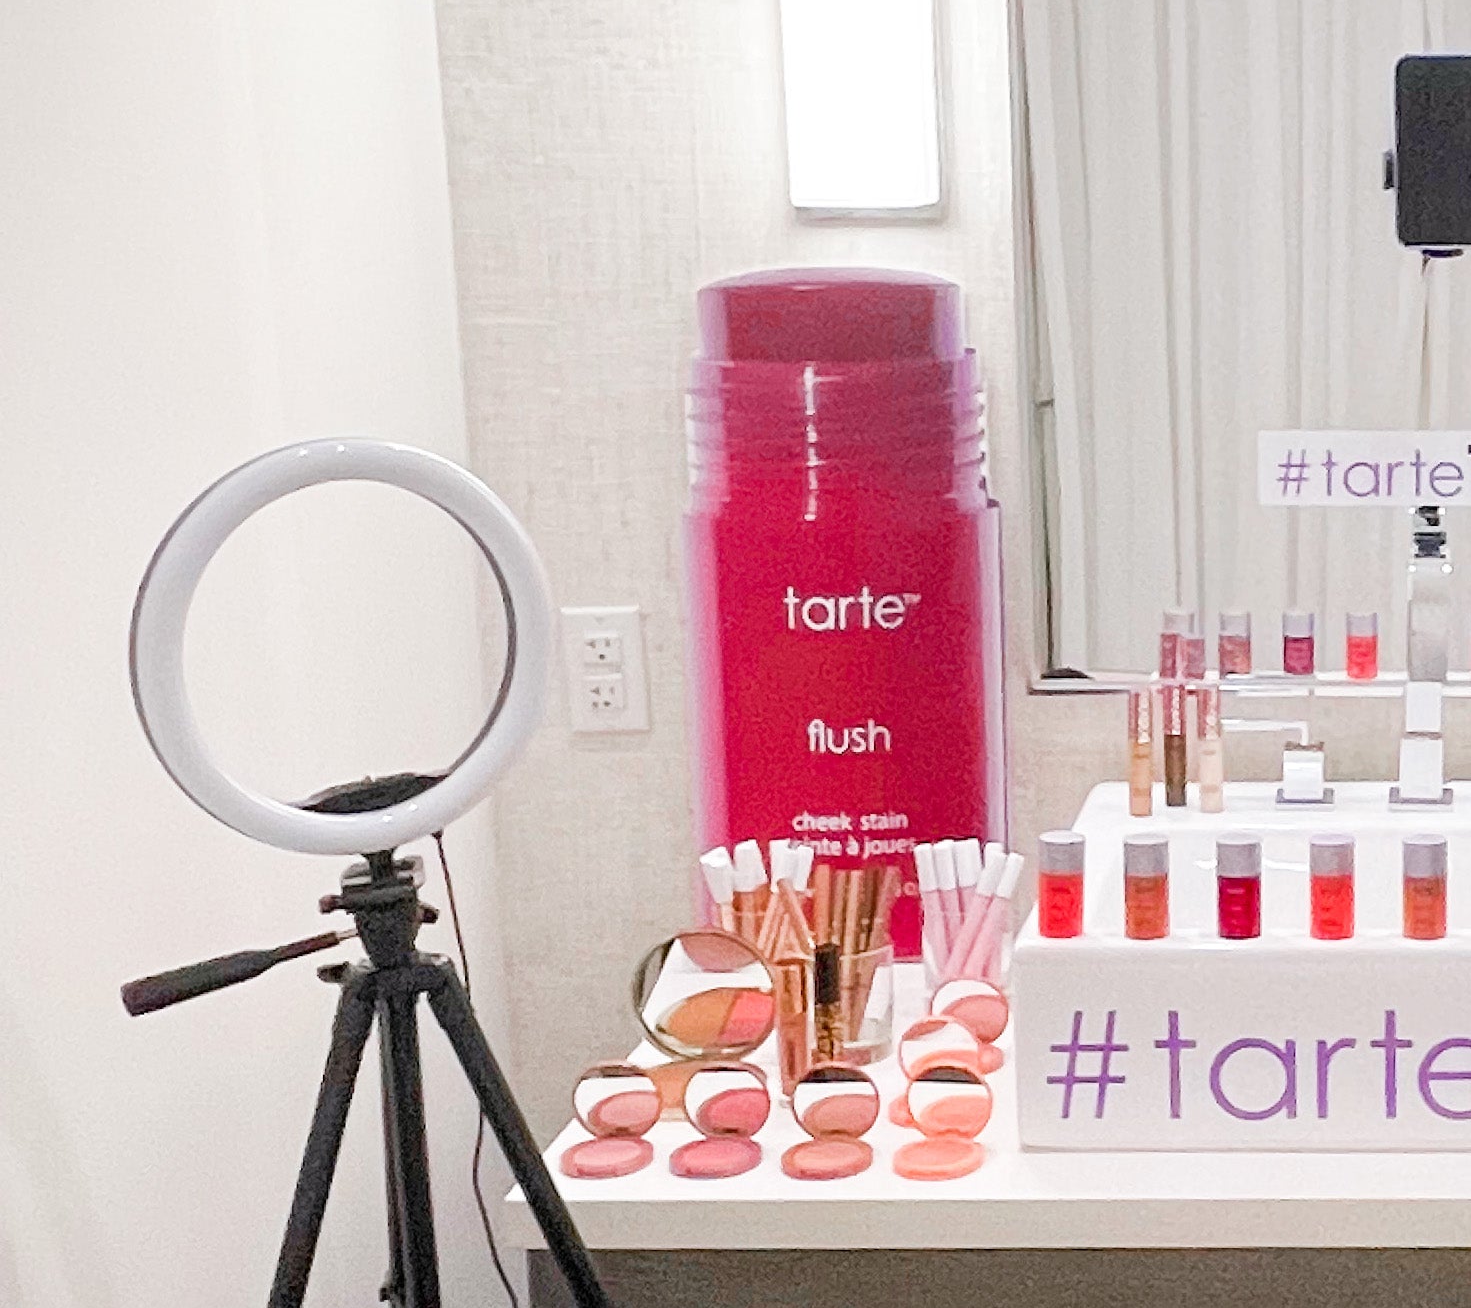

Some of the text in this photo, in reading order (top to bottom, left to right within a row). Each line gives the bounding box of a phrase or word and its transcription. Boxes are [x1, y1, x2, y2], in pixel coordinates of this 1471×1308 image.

[807, 718, 892, 754] flush
[792, 811, 909, 832] cheek stain
